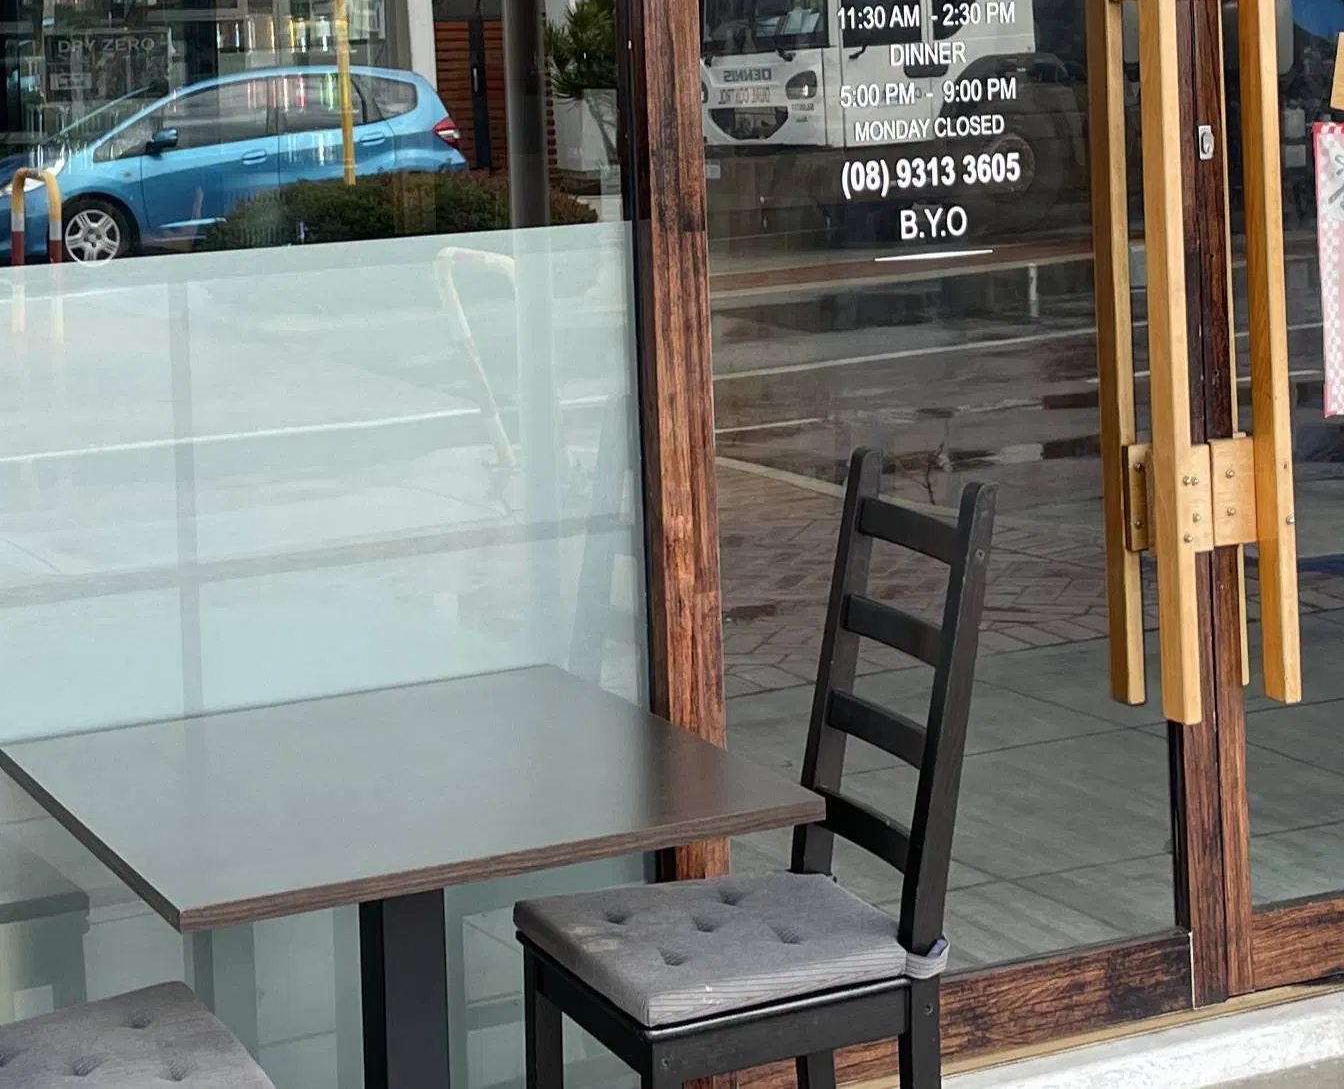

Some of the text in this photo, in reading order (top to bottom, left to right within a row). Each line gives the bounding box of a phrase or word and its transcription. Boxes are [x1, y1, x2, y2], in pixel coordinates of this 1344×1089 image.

[837, 5, 886, 31] 11:30
[889, 5, 921, 29] AM
[942, 3, 981, 27] 2:30
[986, 2, 1016, 25] PM
[102, 37, 156, 52] ZERO
[889, 42, 967, 68] DINNER
[840, 84, 880, 109] 5:00
[884, 83, 915, 107] PM
[943, 80, 982, 103] 9:00
[987, 78, 1017, 101] PM
[854, 114, 1005, 142] MONDAY CLOSED
[841, 152, 1021, 199] (08) 9313 3605
[900, 206, 968, 240] B.Y.O
